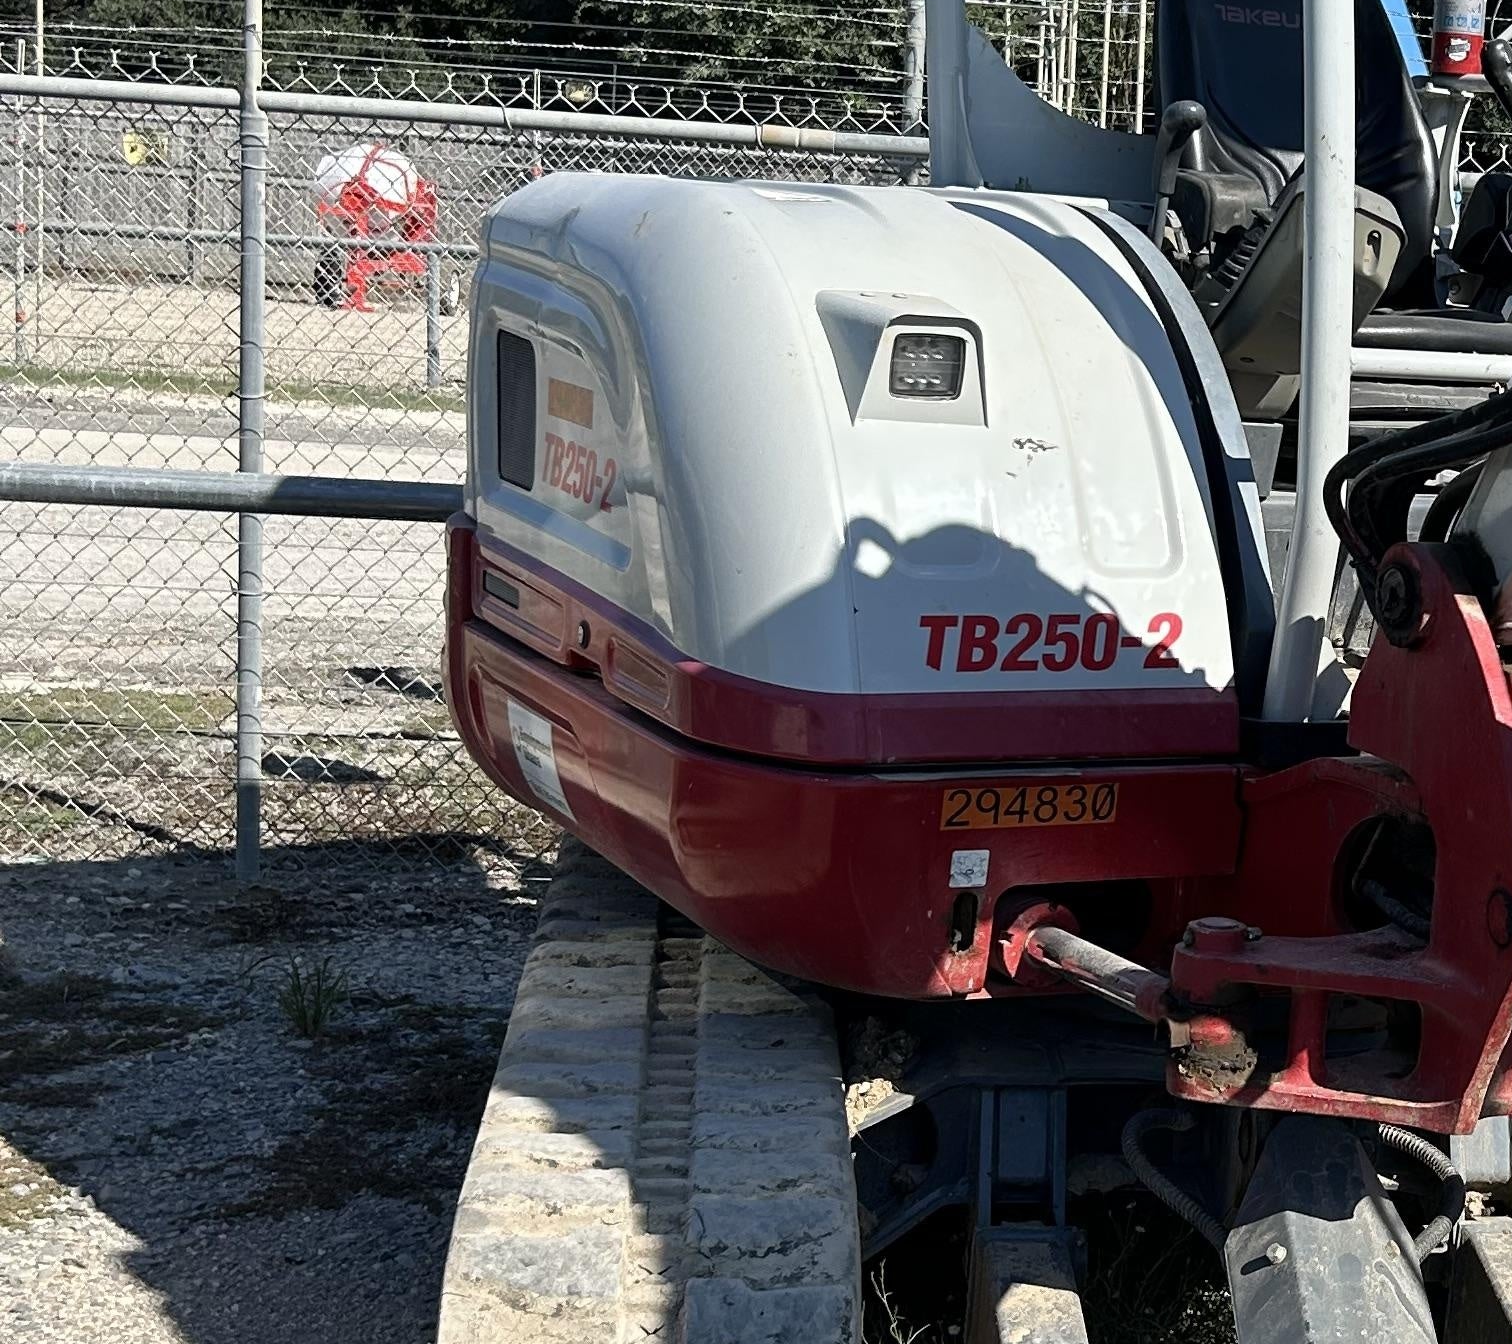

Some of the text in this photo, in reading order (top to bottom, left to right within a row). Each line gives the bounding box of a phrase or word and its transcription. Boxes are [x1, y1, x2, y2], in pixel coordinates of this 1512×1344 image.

[541, 431, 617, 514] TB250-2
[918, 611, 1184, 673] TB250-2
[943, 782, 1117, 827] 294830
